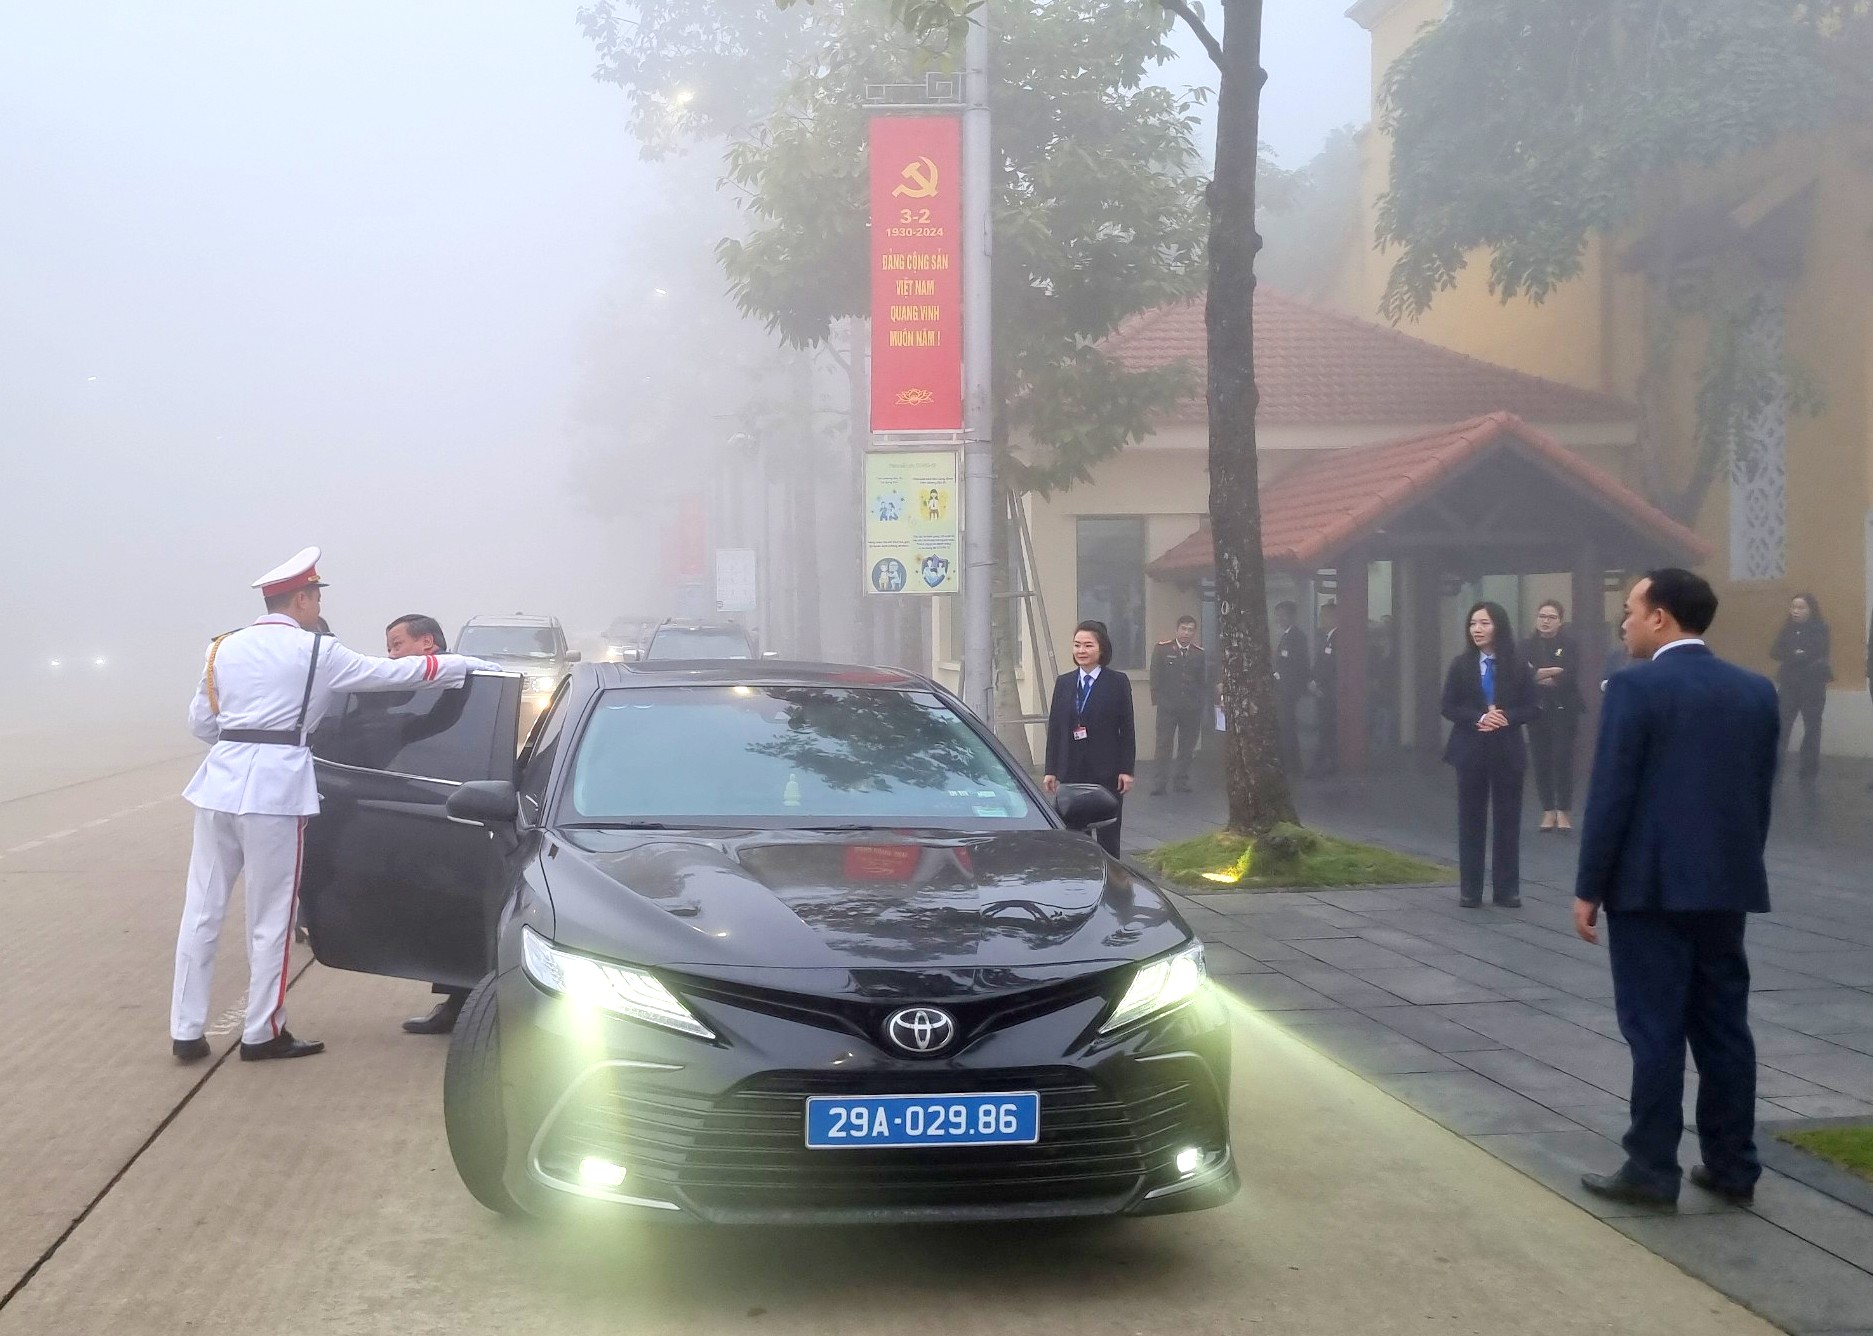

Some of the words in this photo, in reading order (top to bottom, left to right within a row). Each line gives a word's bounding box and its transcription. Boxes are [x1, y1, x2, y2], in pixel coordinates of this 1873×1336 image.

[900, 208, 931, 224] 3-2
[886, 227, 944, 237] 1930-2024
[881, 247, 905, 270] ĐẢNG
[906, 250, 930, 274] CỘNG
[931, 247, 949, 270] SẢN
[896, 276, 914, 299] VIỆT
[915, 279, 935, 296] NAM
[890, 305, 918, 322] QUANG
[919, 305, 940, 321] VINH
[828, 1103, 1018, 1138] 29A-029.86
